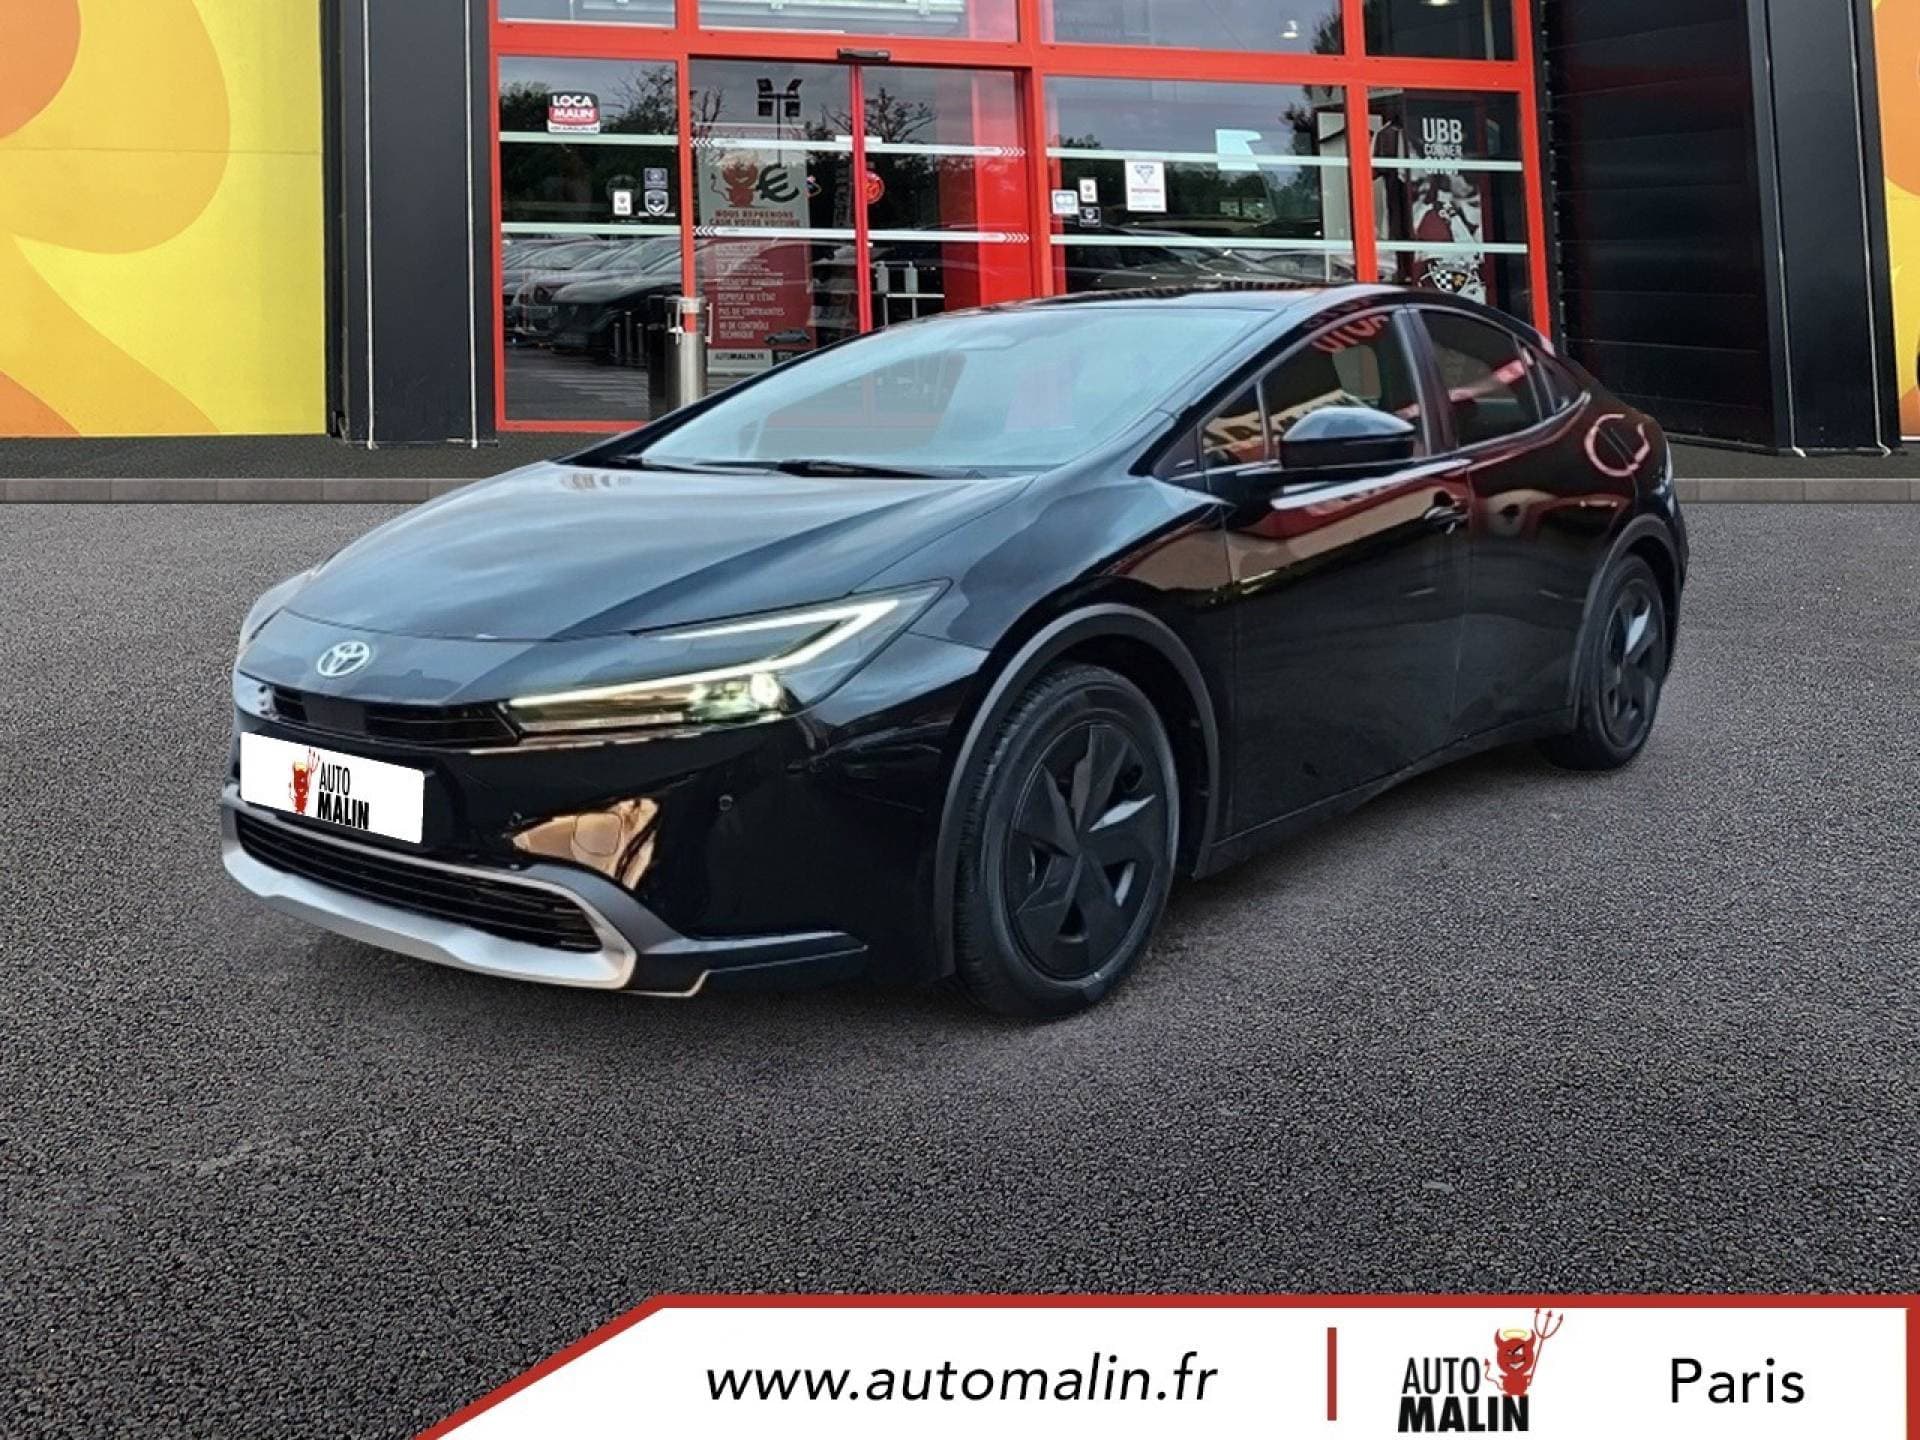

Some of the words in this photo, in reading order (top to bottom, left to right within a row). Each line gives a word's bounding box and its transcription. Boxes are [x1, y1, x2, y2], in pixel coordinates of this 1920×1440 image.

[552, 95, 593, 107] LOCA
[553, 108, 593, 118] MALIN
[1422, 118, 1463, 143] UBB
[1424, 143, 1462, 157] CORNER
[319, 762, 351, 796] AUTO
[317, 791, 370, 830] MALIN
